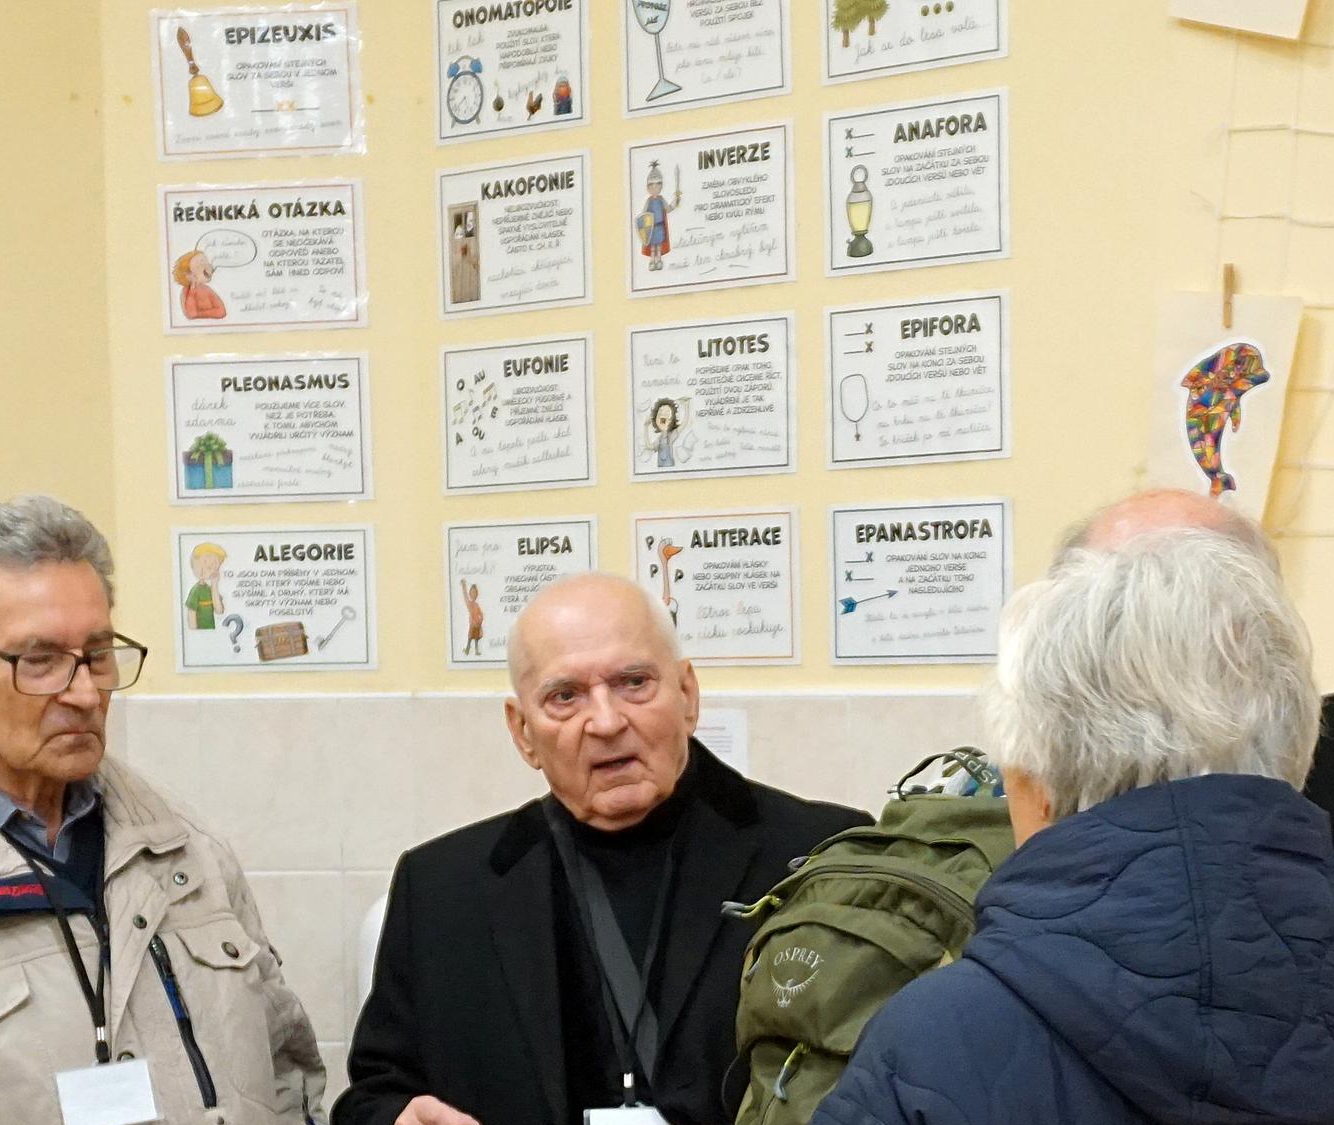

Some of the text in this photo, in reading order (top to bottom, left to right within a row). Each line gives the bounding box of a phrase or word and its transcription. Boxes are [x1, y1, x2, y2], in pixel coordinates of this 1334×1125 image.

[225, 22, 336, 45] EPIZEUXIS
[893, 112, 987, 143] ANAFORA
[698, 141, 770, 170] INVERZE
[881, 167, 902, 175] SLOV
[950, 159, 961, 167] ZA
[949, 170, 969, 178] NEBO
[481, 171, 575, 200] KAKOFONIE
[173, 197, 346, 222] ŘEČNICKÁ OTÁZKA
[694, 204, 708, 212] PRO
[755, 195, 775, 204] EFEKT
[705, 213, 723, 221] NEBO
[901, 313, 981, 339] EPIFORA
[698, 333, 769, 358] LITOTES
[503, 354, 569, 378] EUFONIE
[887, 363, 907, 371] SLOV
[958, 356, 984, 364] SEBOU
[949, 367, 969, 376] NEBO
[221, 373, 350, 392] PLEONASMUS
[457, 379, 465, 391] O
[474, 369, 485, 384] AU
[687, 378, 697, 386] CO
[491, 406, 498, 419] E
[456, 432, 463, 445] A
[691, 527, 781, 548] ALITERACE
[856, 519, 992, 543] EPANASTROFA
[518, 536, 572, 556] ELIPSA
[646, 536, 654, 550] P
[254, 543, 355, 562] ALEGORIE
[929, 553, 949, 561] SLOV
[650, 564, 658, 578] P
[675, 569, 684, 582] P
[774, 946, 821, 968] OSPREY
